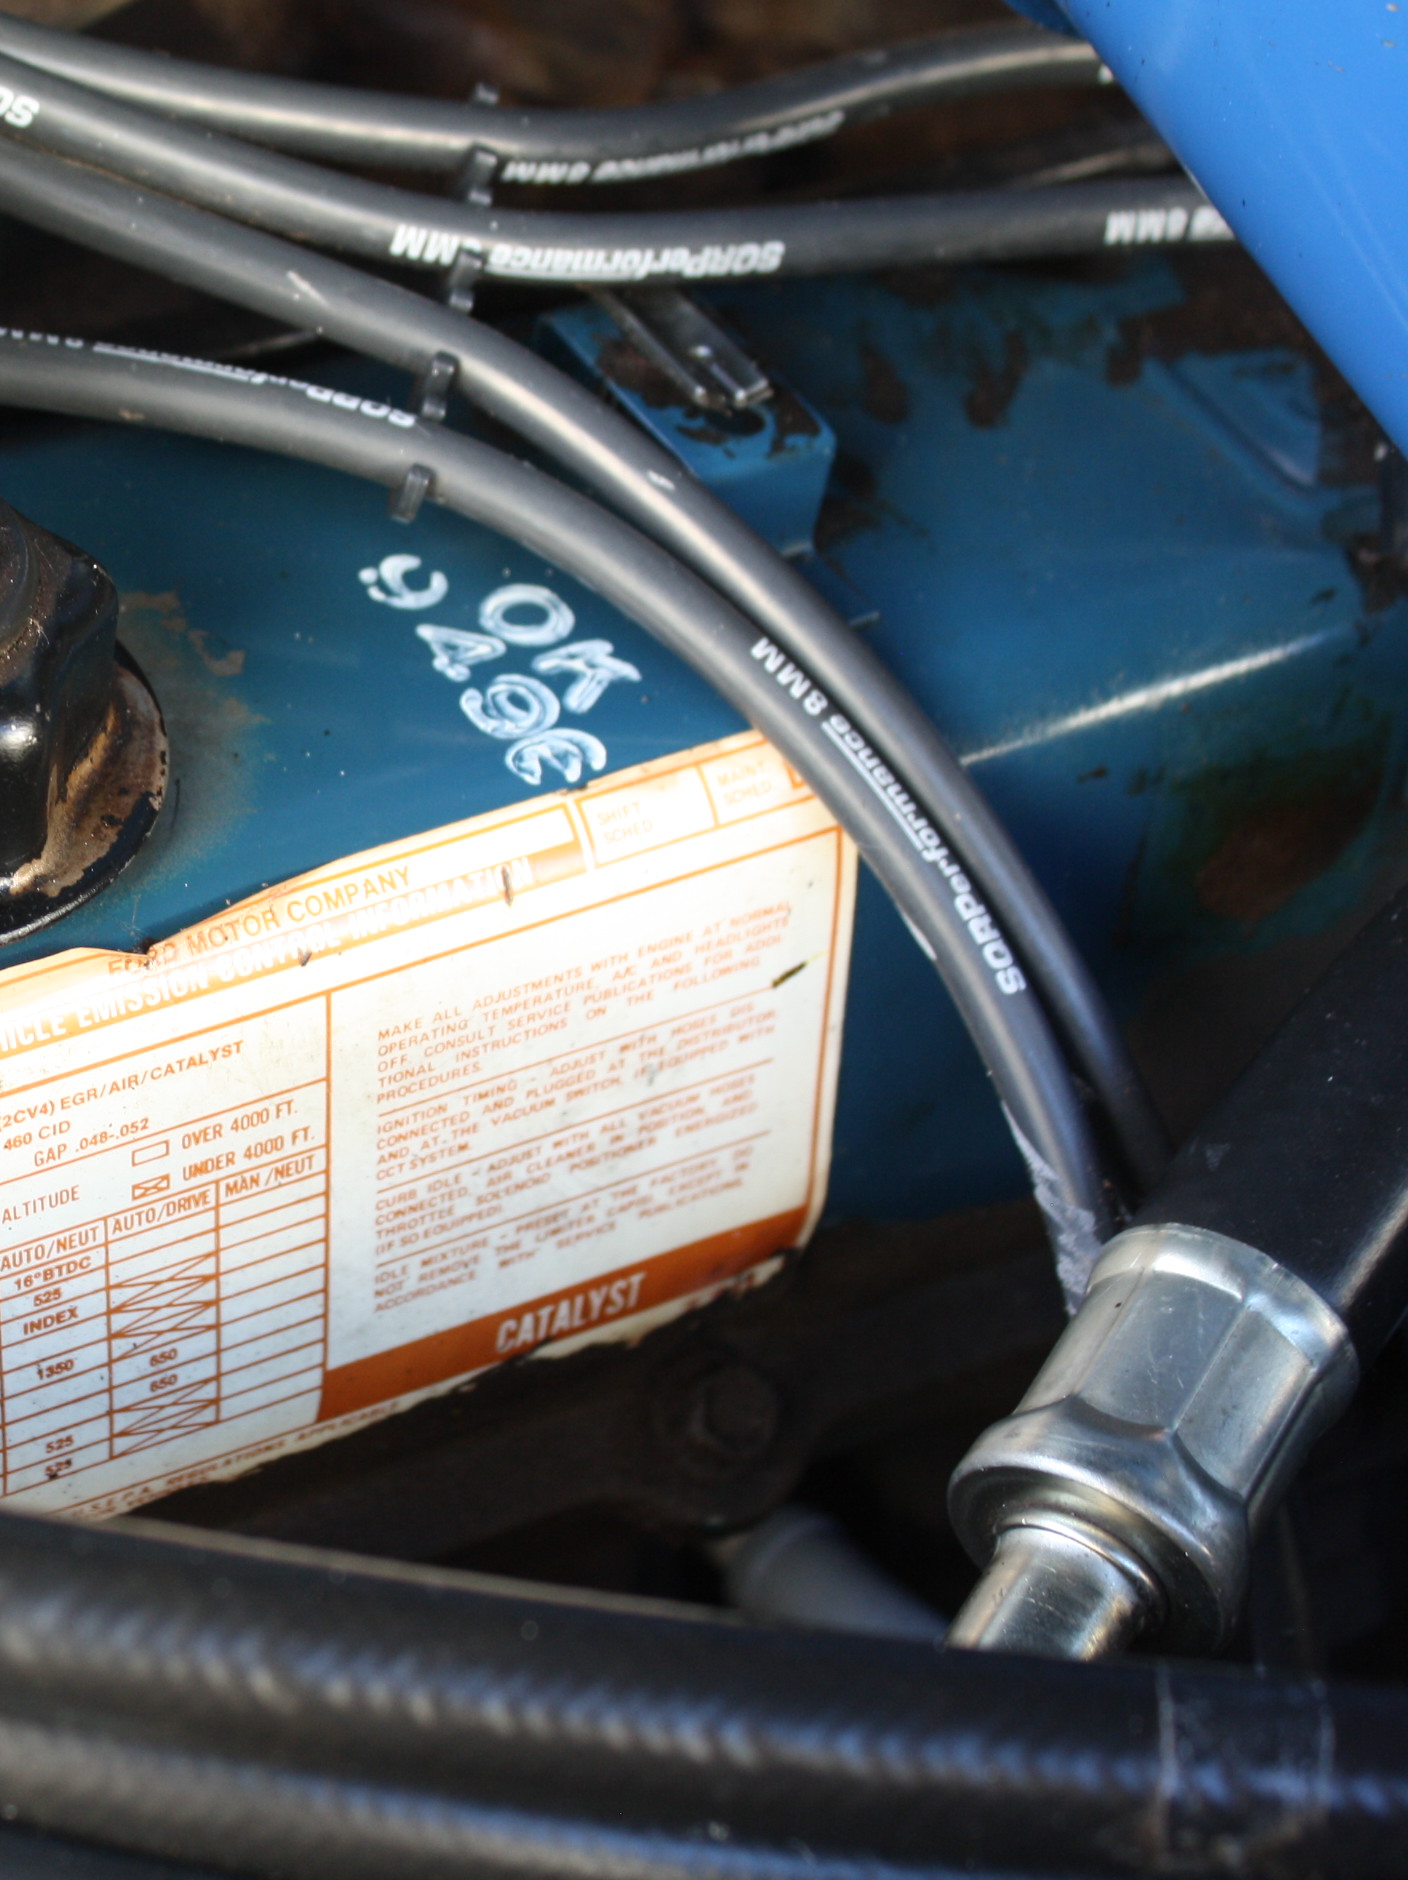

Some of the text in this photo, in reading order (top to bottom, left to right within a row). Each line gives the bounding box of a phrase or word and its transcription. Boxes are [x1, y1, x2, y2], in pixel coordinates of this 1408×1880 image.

[751, 636, 829, 717] 8MM
[596, 800, 640, 825] SHIFT
[78, 966, 209, 1030] EMISSION
[217, 922, 340, 986] CONTROL
[349, 855, 535, 938] INFORMATION
[185, 909, 280, 960] MOTOR
[288, 865, 412, 923] COMPANY
[378, 901, 792, 1041] MAKE ALL ADJUSTMENTS WITH ENGINE AT NORMAL
[378, 1019, 469, 1058] OPERATING
[651, 950, 683, 969] AND
[695, 916, 789, 955] HEADLIGHTS
[424, 1027, 496, 1059] CONSULT
[507, 1002, 571, 1031] SERVICE
[583, 963, 693, 1006] PUBLICATIONS
[703, 948, 733, 967] FOR
[378, 956, 761, 1088] TIONAL INSTRUCTIONS ON THE FOLLOWING
[60, 1040, 244, 1110] EGR/AIR/CATALYST
[376, 1009, 778, 1151] CONNECTED AND PLUGGED AT THE DISTRIBUTOR
[377, 1103, 449, 1134] IGNITION
[463, 1079, 518, 1106] TIMING
[549, 1049, 606, 1077] ADJUST
[619, 1033, 658, 1054] WITH
[377, 1146, 410, 1167] AND
[420, 1136, 440, 1152] AT
[451, 1122, 480, 1142] THE
[491, 1097, 556, 1127] VACUUM
[657, 1040, 729, 1072] EQUIPPED
[1, 1099, 297, 1224] ALTITUDE OVER 4000 FT.
[3, 1132, 33, 1151] 460
[39, 1120, 71, 1140] CID
[35, 1143, 67, 1168] GAP
[75, 1118, 150, 1153] .048-.052
[182, 1126, 315, 1181] UNDER 4000 FT.
[376, 1189, 417, 1212] CURB
[427, 1173, 463, 1195] IDLE
[488, 1145, 543, 1173] ADJUST
[552, 1130, 591, 1150] WITH
[526, 1143, 597, 1175] CLEANER
[0, 1225, 100, 1272] AUTO/NEUT
[112, 1189, 211, 1235] AUTO/DRIVE
[225, 1173, 260, 1198] MAN
[375, 1204, 456, 1240] THROTTLE
[476, 1171, 552, 1206] SOLENOID
[33, 1288, 62, 1308] 525
[374, 1265, 410, 1285] IDLE
[420, 1236, 490, 1269] MIXTURE
[23, 1306, 79, 1335] INDEX
[494, 1271, 648, 1354] CATALYST
[37, 1359, 74, 1381] 1350
[45, 1435, 74, 1454] 525
